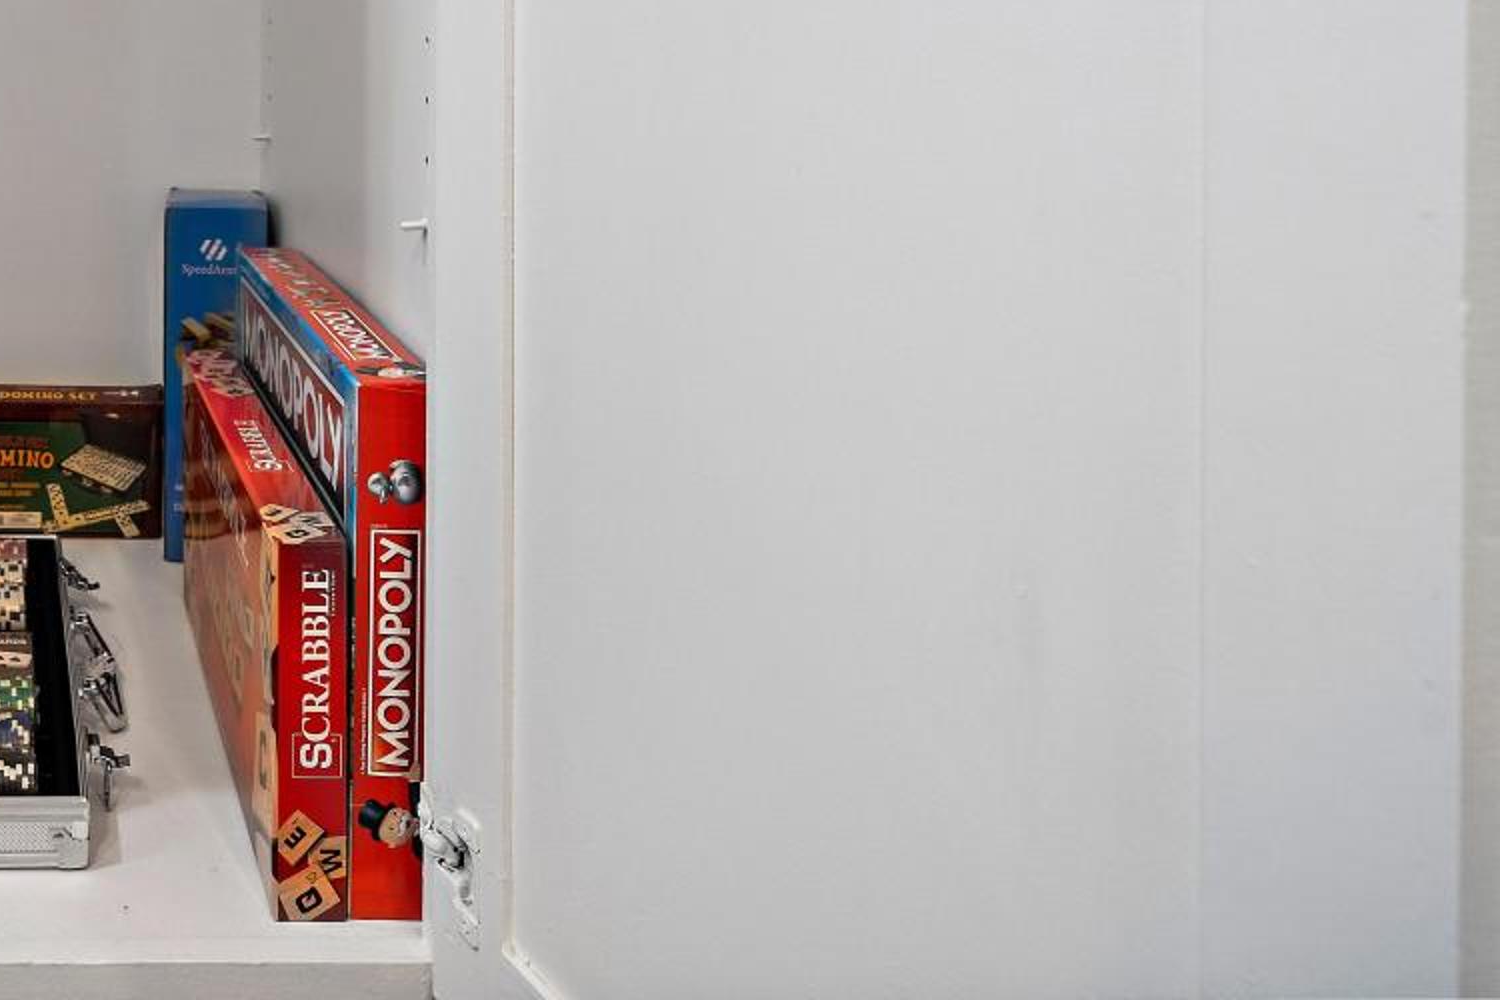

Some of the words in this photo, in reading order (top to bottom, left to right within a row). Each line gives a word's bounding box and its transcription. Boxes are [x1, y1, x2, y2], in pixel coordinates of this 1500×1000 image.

[0, 390, 64, 400] DOMINO
[68, 391, 98, 401] SET
[244, 297, 342, 491] MONOPOLY
[299, 568, 333, 769] SCRABBLE
[376, 537, 412, 768] MONOPOLY
